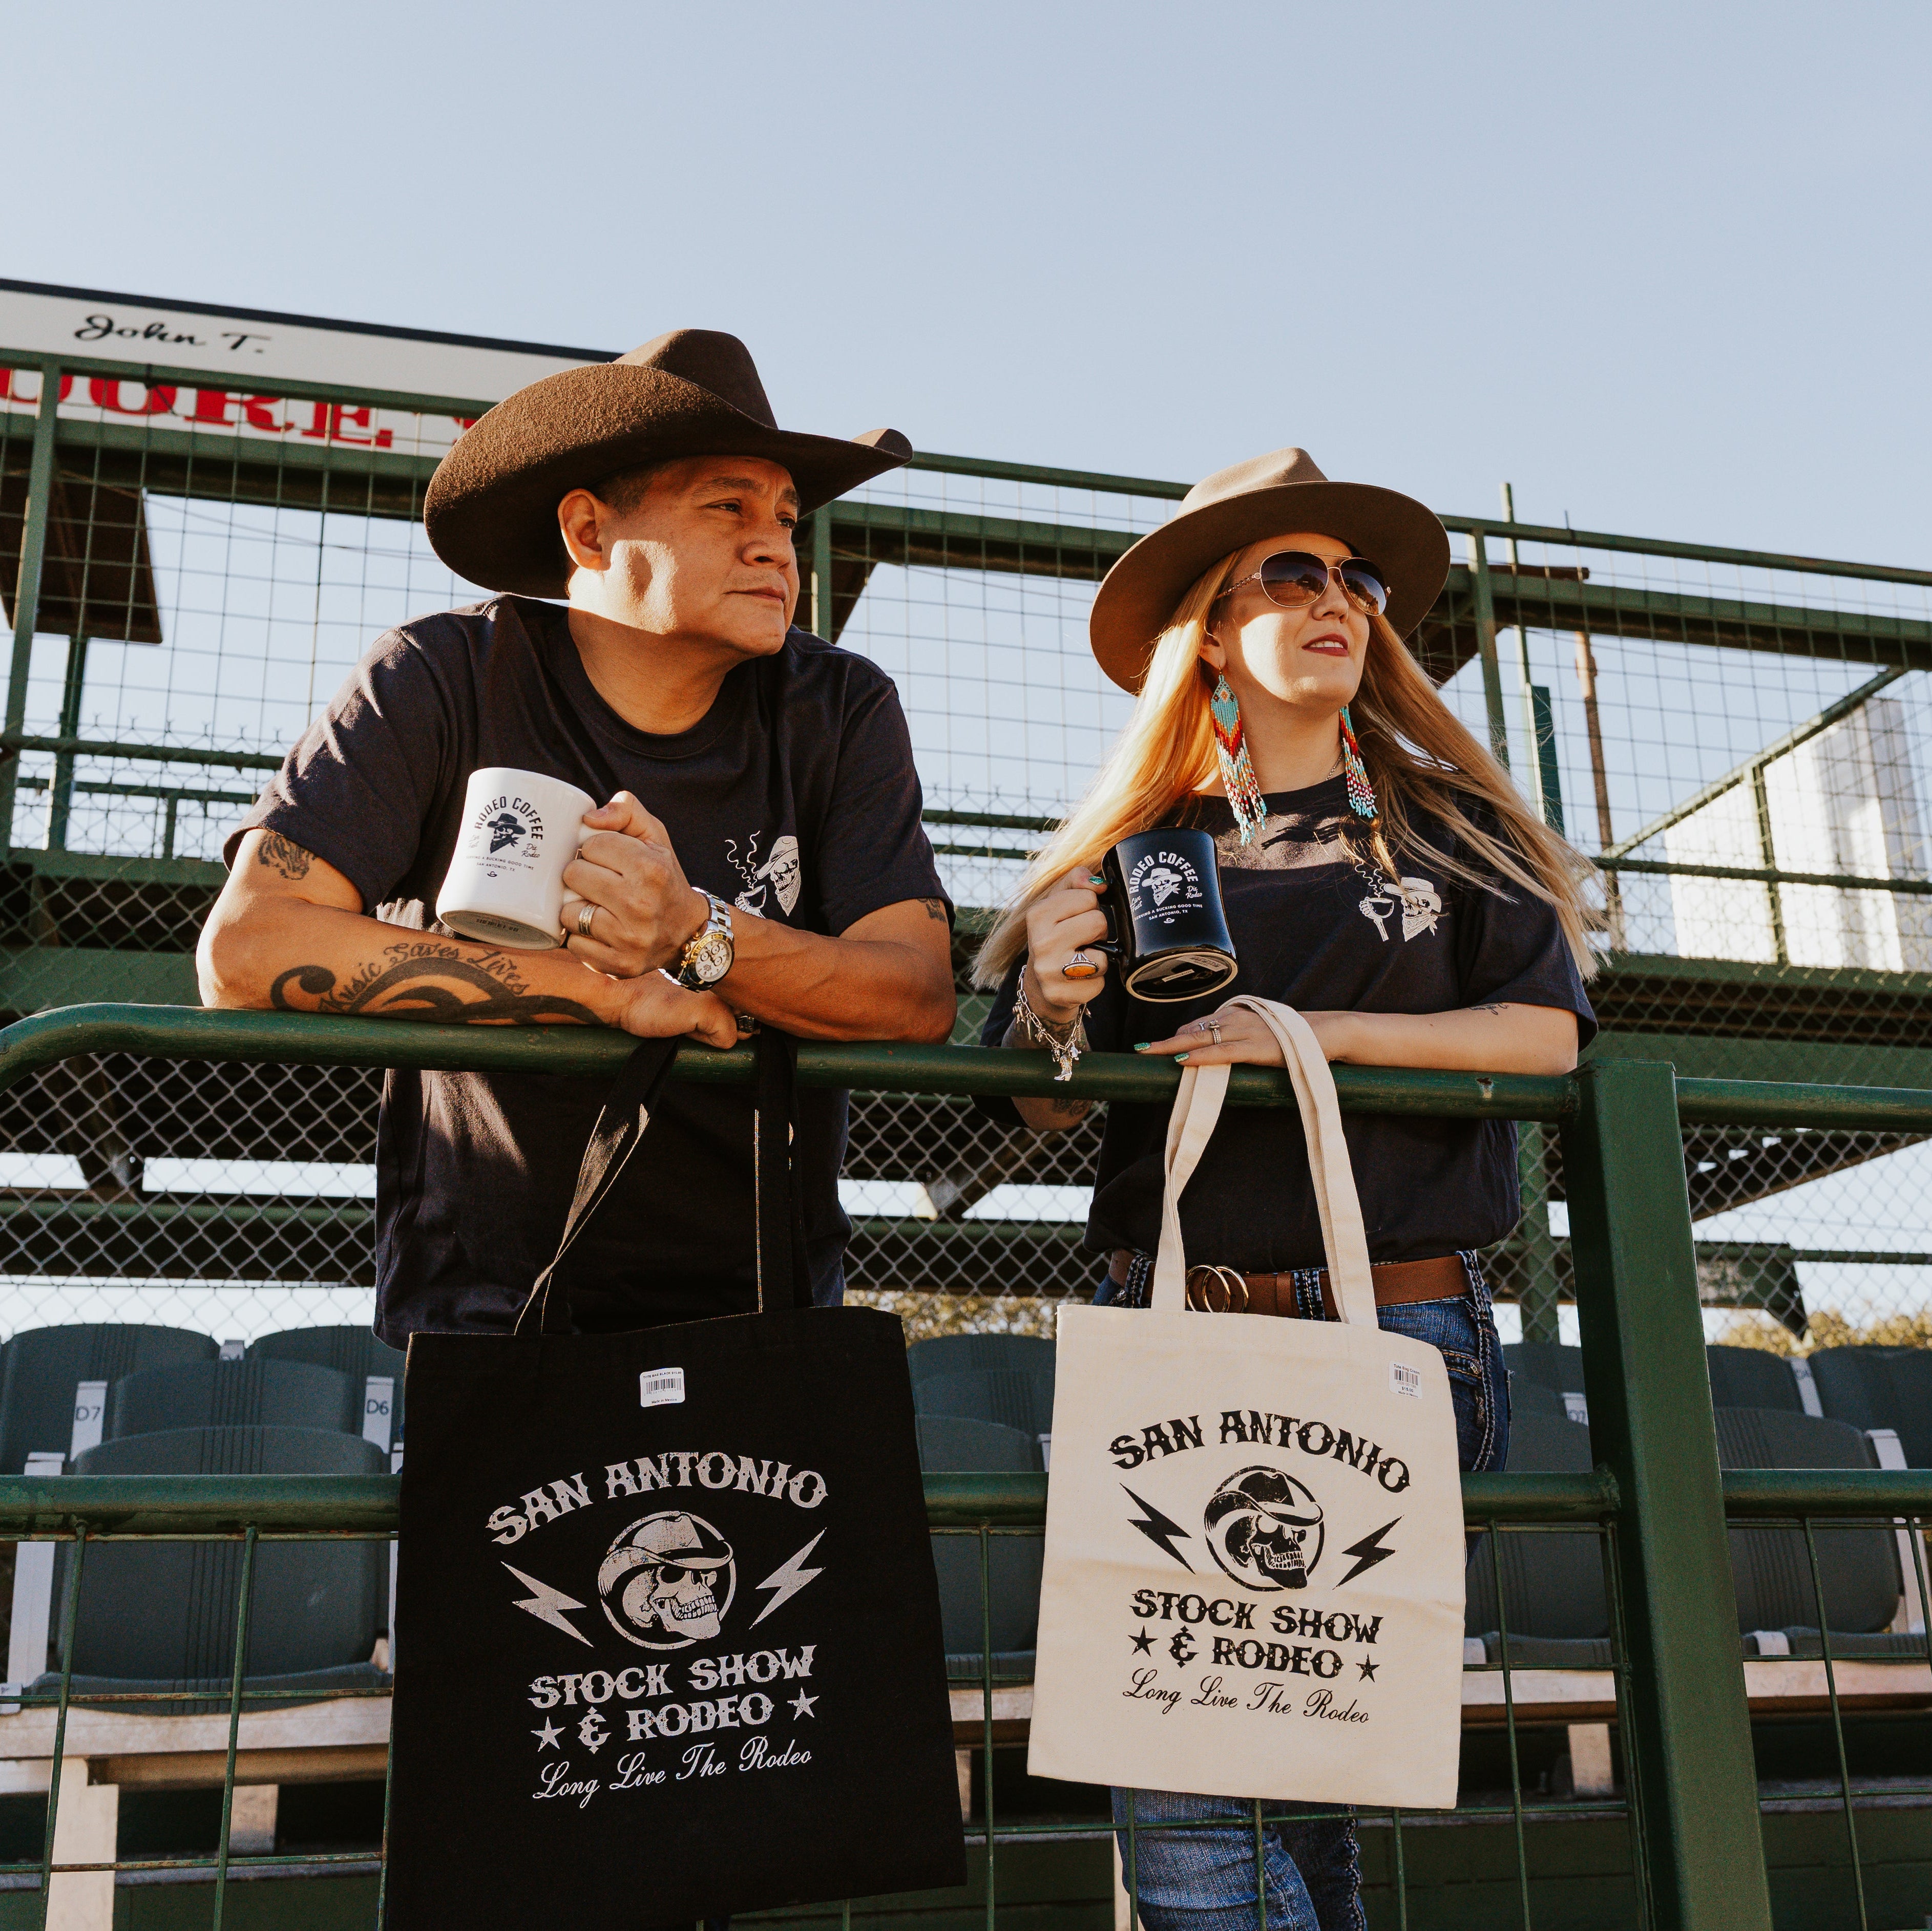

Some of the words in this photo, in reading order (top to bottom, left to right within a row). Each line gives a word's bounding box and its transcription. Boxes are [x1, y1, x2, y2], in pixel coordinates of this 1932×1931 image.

[74, 314, 206, 346] John
[221, 331, 271, 353] T.
[474, 796, 507, 829] RODEO
[512, 797, 543, 840] COFFEE
[521, 850, 540, 858] Rodeo
[1129, 855, 1155, 894] RODEO
[1159, 852, 1199, 882] COFFEE
[1134, 911, 1151, 921] SERVING
[383, 943, 462, 967] Saves
[467, 948, 531, 995] Lives
[75, 1406, 100, 1421] D7
[367, 1399, 389, 1416] D6
[1107, 1415, 1205, 1470] SAN
[1219, 1410, 1411, 1493] ANTONIO
[486, 1472, 594, 1544] SAN
[604, 1452, 829, 1509] ANTONIO
[1128, 1588, 1256, 1630] STOCK
[1270, 1605, 1384, 1644] SHOW
[528, 1664, 674, 1709] STOCK
[687, 1645, 817, 1690] SHOW
[1168, 1626, 1200, 1668] &
[1211, 1636, 1345, 1679] RODEO
[1123, 1668, 1183, 1714] Long
[1190, 1675, 1238, 1709] Live
[1246, 1681, 1292, 1715] The
[1304, 1688, 1371, 1724] Rodeo
[577, 1706, 612, 1754] &
[626, 1692, 774, 1741] RODEO
[532, 1761, 600, 1809] Long
[609, 1752, 666, 1790] Live
[676, 1744, 727, 1780] The
[739, 1735, 812, 1771] Rodeo
